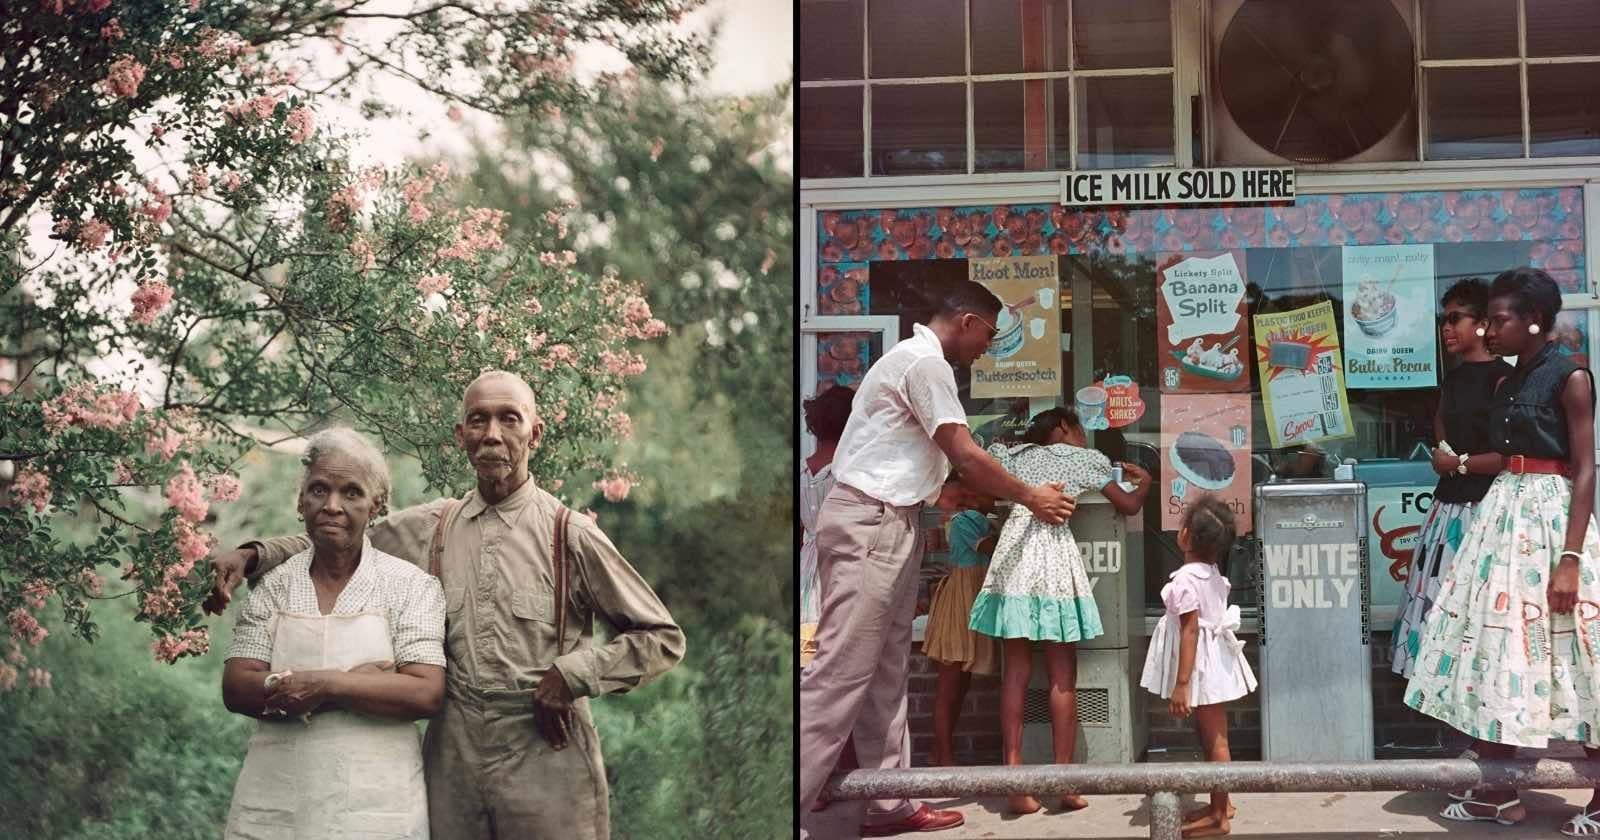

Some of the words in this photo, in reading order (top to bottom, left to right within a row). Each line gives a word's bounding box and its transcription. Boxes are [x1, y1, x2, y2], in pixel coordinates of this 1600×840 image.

[1066, 174, 1103, 202] ICE
[1111, 172, 1172, 201] MILK
[1178, 170, 1236, 200] SOLD
[1242, 169, 1294, 198] HERE
[973, 263, 1010, 280] Hoot
[1168, 281, 1238, 296] Banana
[1178, 298, 1228, 318] Split
[1392, 347, 1414, 355] QUEEN
[1392, 357, 1433, 373] Pecan
[975, 368, 1057, 383] Butterscotch
[1109, 408, 1137, 420] SHAKES
[1264, 543, 1359, 577] WHITE
[1271, 578, 1355, 609] ONLY
